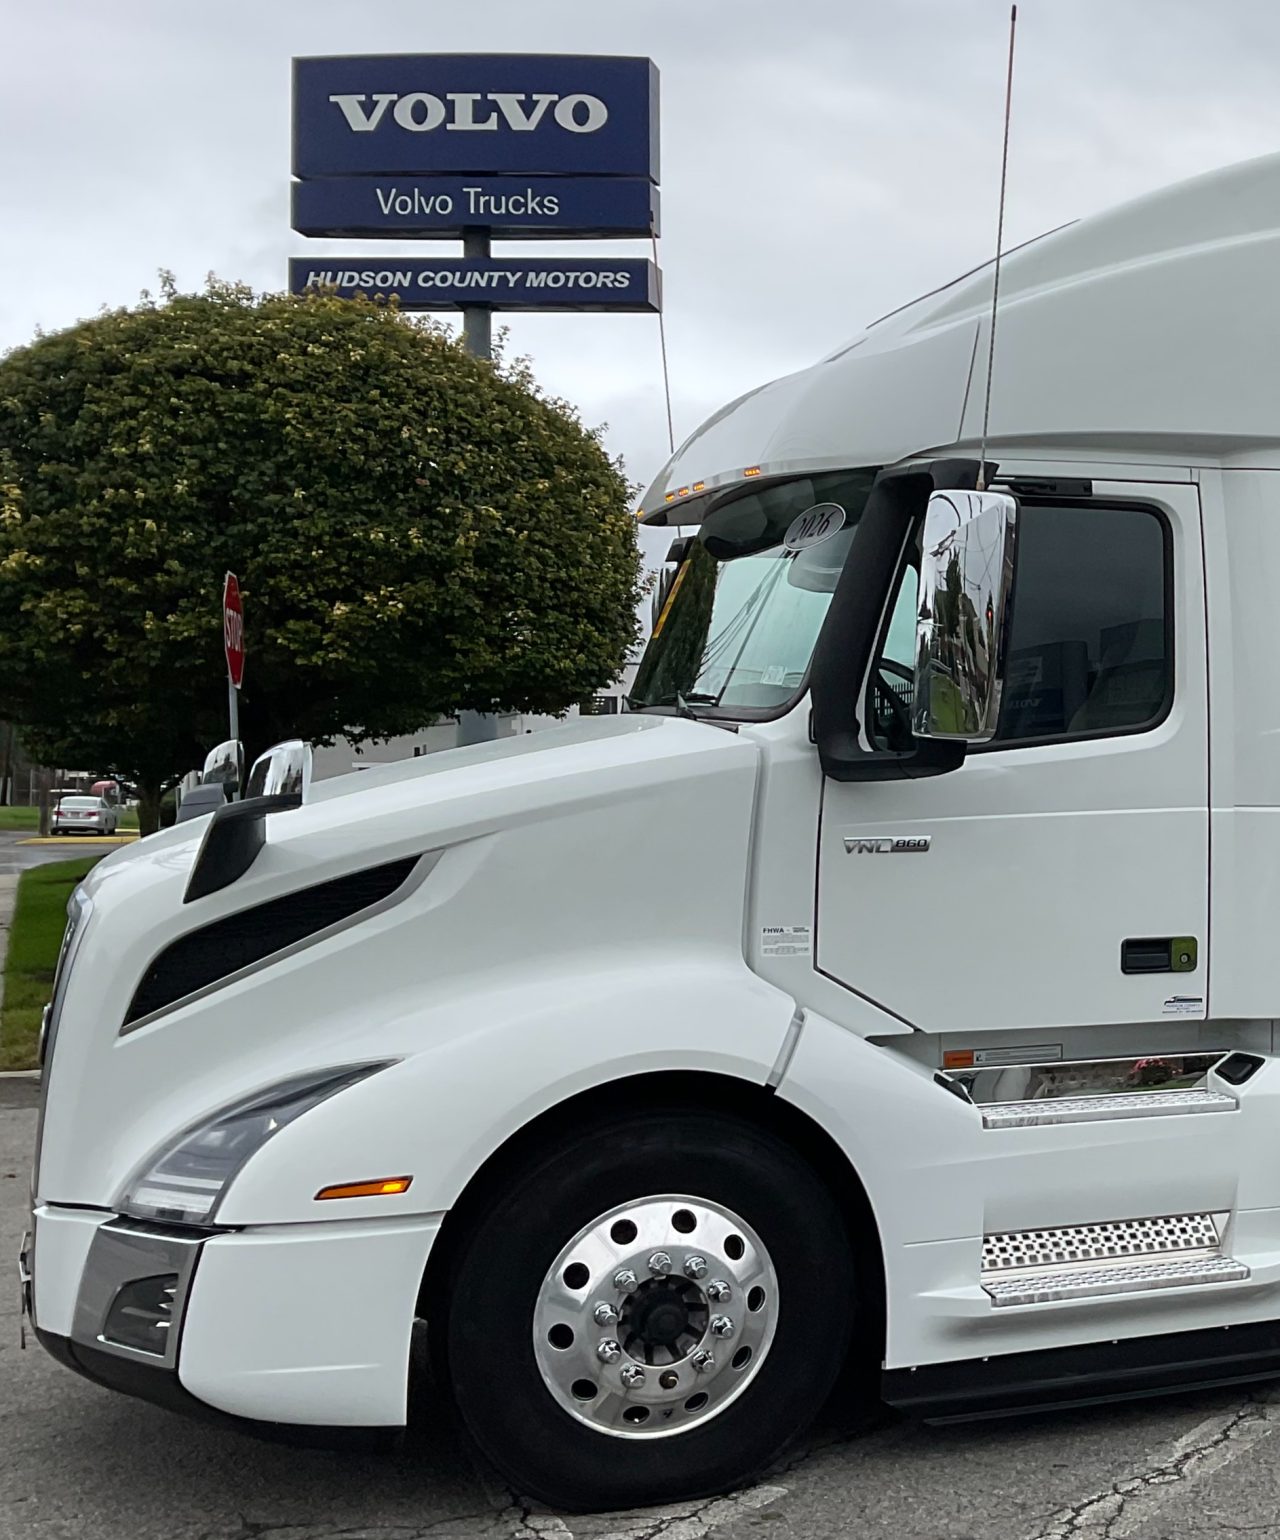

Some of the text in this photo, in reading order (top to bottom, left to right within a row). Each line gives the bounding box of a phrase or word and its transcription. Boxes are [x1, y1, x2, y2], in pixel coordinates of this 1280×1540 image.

[329, 93, 608, 133] VOLVO
[376, 187, 559, 215] Volvo Trucks
[306, 271, 631, 288] HUDSON COUNTY MOTORS
[790, 509, 838, 543] 2026
[226, 607, 242, 652] STOP
[844, 838, 928, 854] VNL 860
